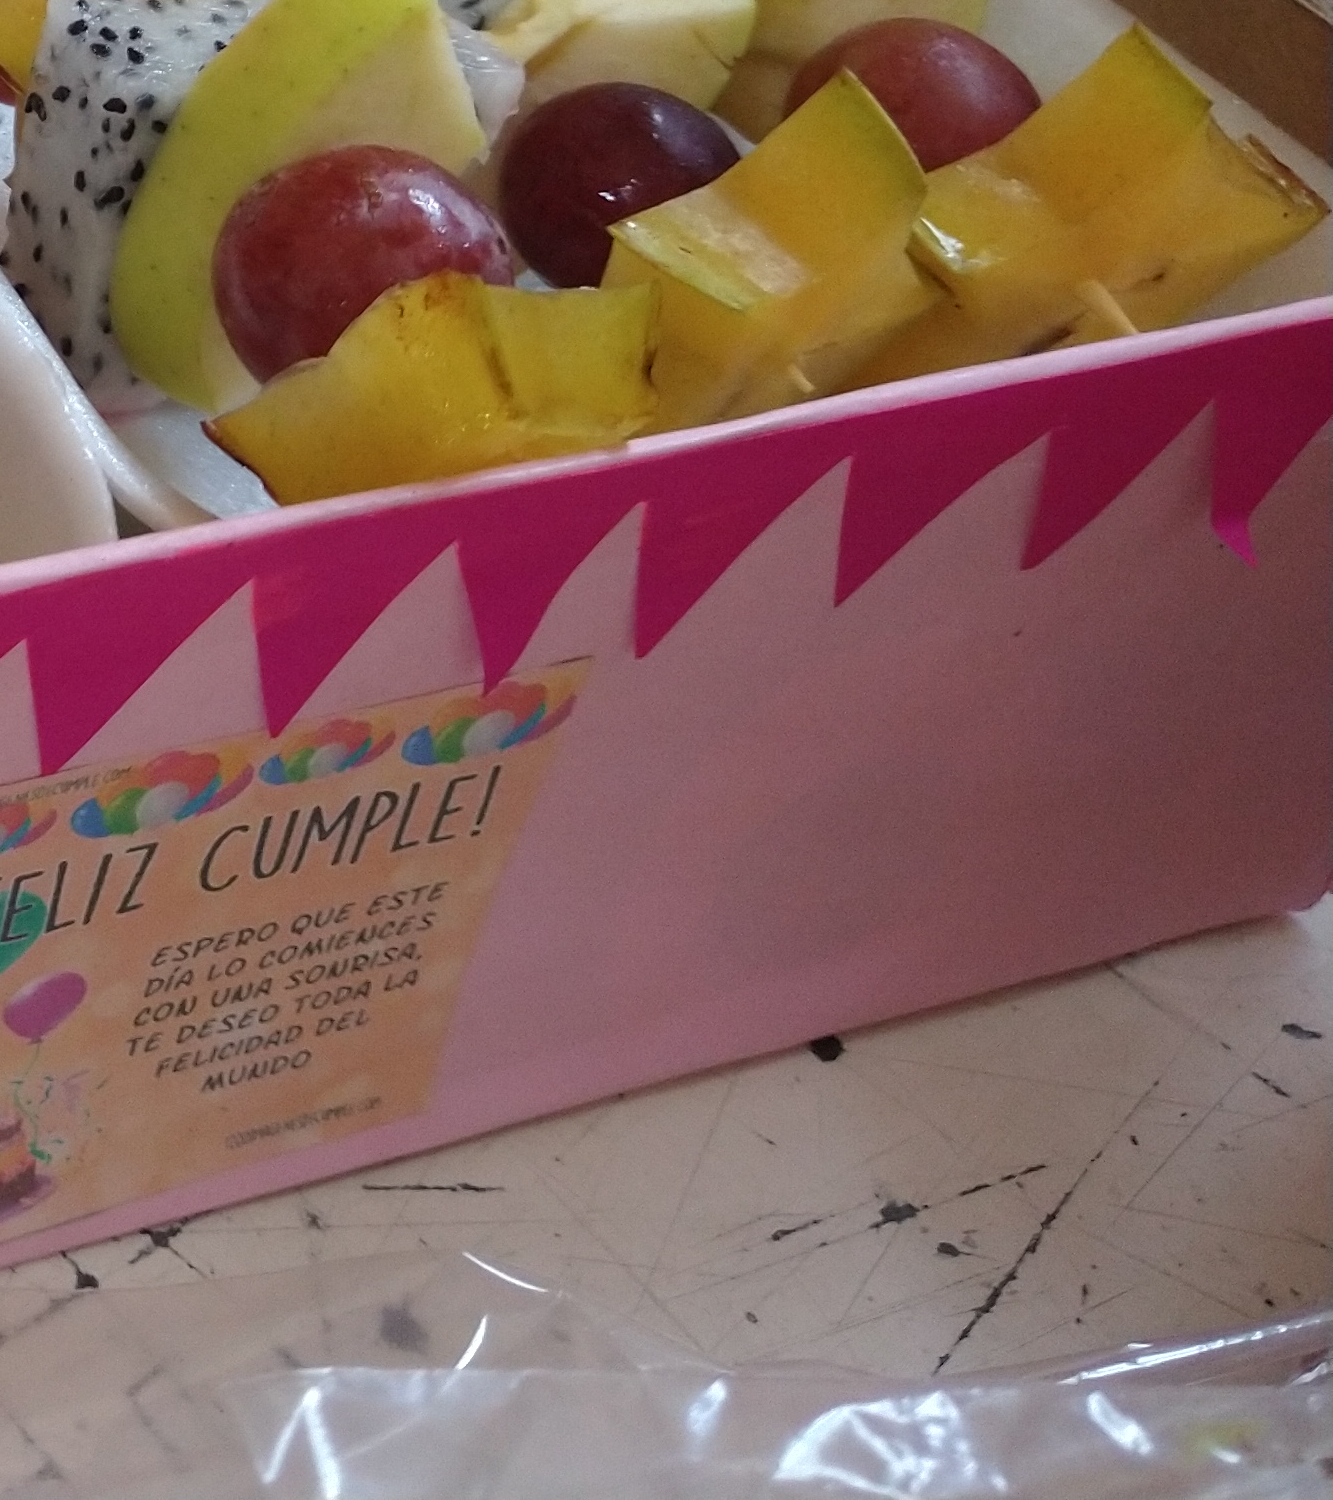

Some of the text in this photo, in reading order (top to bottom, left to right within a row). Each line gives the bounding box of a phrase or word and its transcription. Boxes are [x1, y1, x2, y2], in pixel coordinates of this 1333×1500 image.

[199, 765, 502, 892] CUMPLE!
[144, 911, 437, 998] DÍA LO COMIENCES
[150, 881, 449, 968] ESPERO QUE ESTE
[125, 969, 419, 1057] TE DESEO TODA LA
[133, 996, 197, 1028] CON
[211, 977, 272, 1009] UNA
[155, 1008, 372, 1079] FELICIDAD DEL
[201, 1049, 312, 1093] MUNDO
